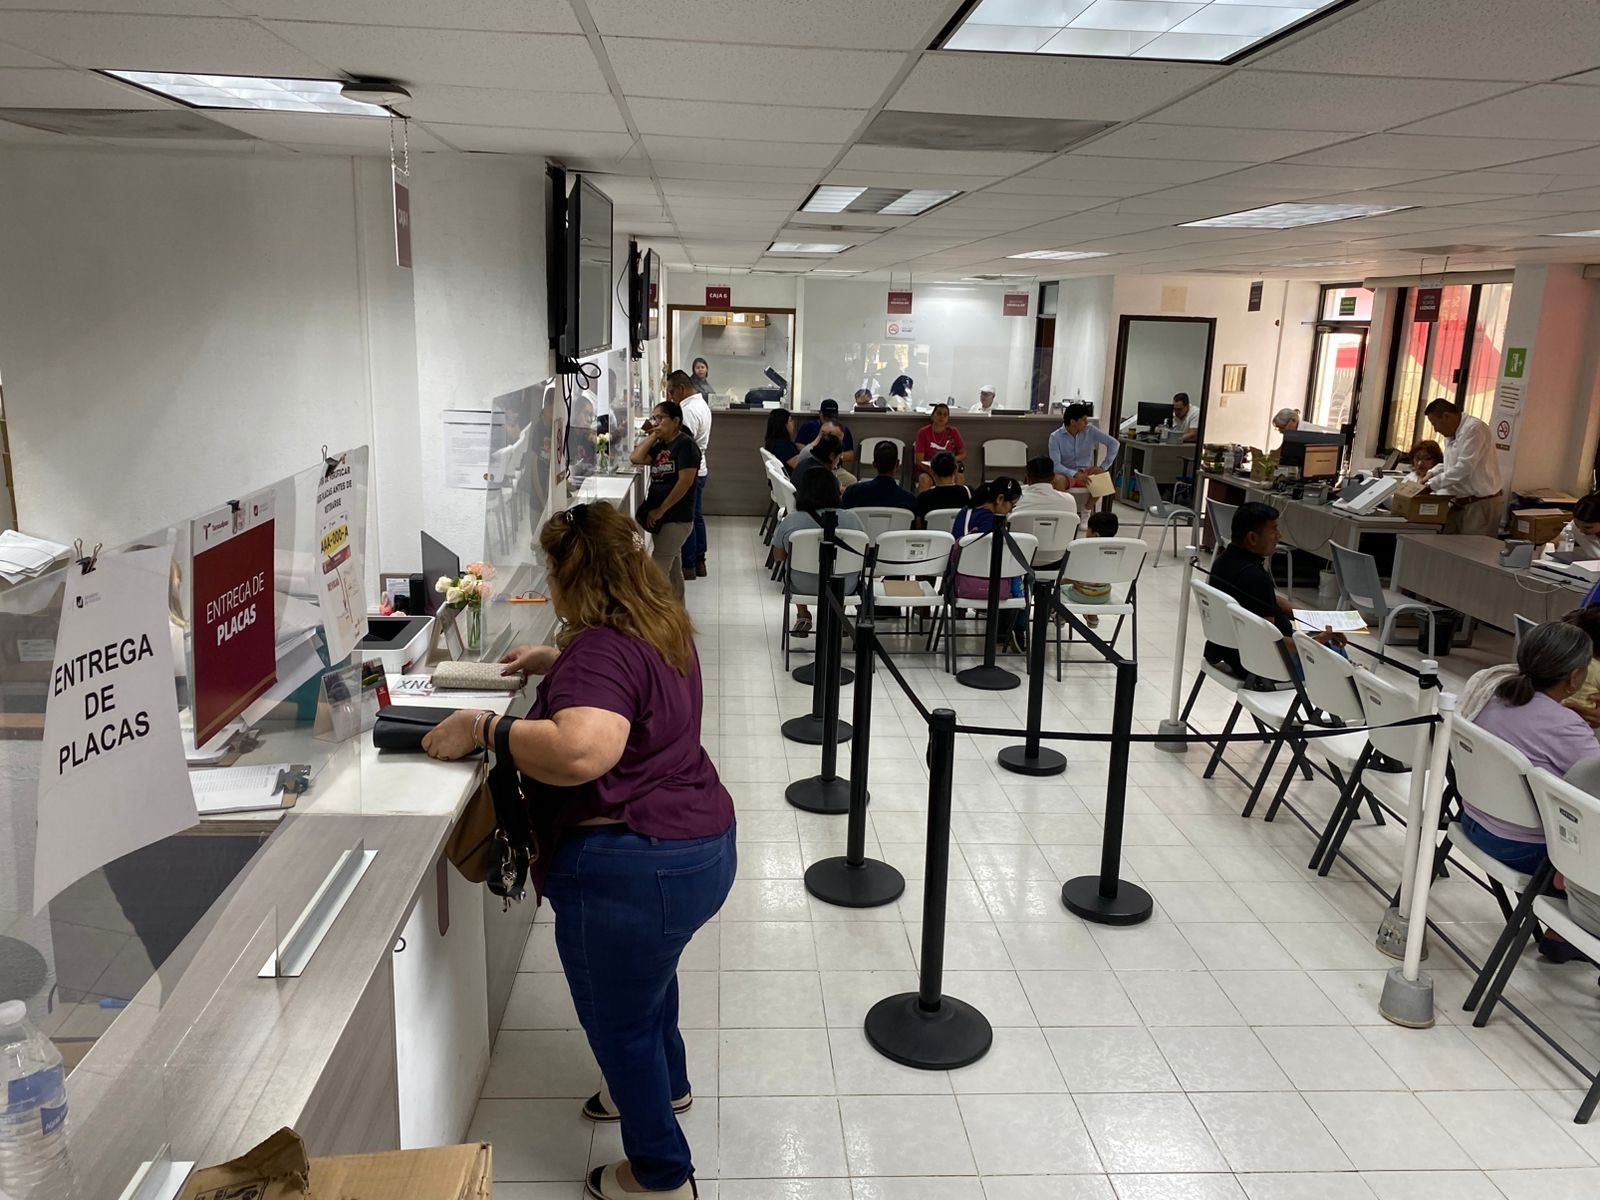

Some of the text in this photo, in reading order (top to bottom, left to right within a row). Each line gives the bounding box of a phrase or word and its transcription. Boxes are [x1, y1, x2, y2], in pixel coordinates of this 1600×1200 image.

[206, 571, 265, 624] ENTREGA DE
[217, 603, 257, 646] PLACAS
[54, 633, 154, 697] ENTREGA
[85, 684, 116, 720] DE
[59, 711, 150, 776] PLACAS
